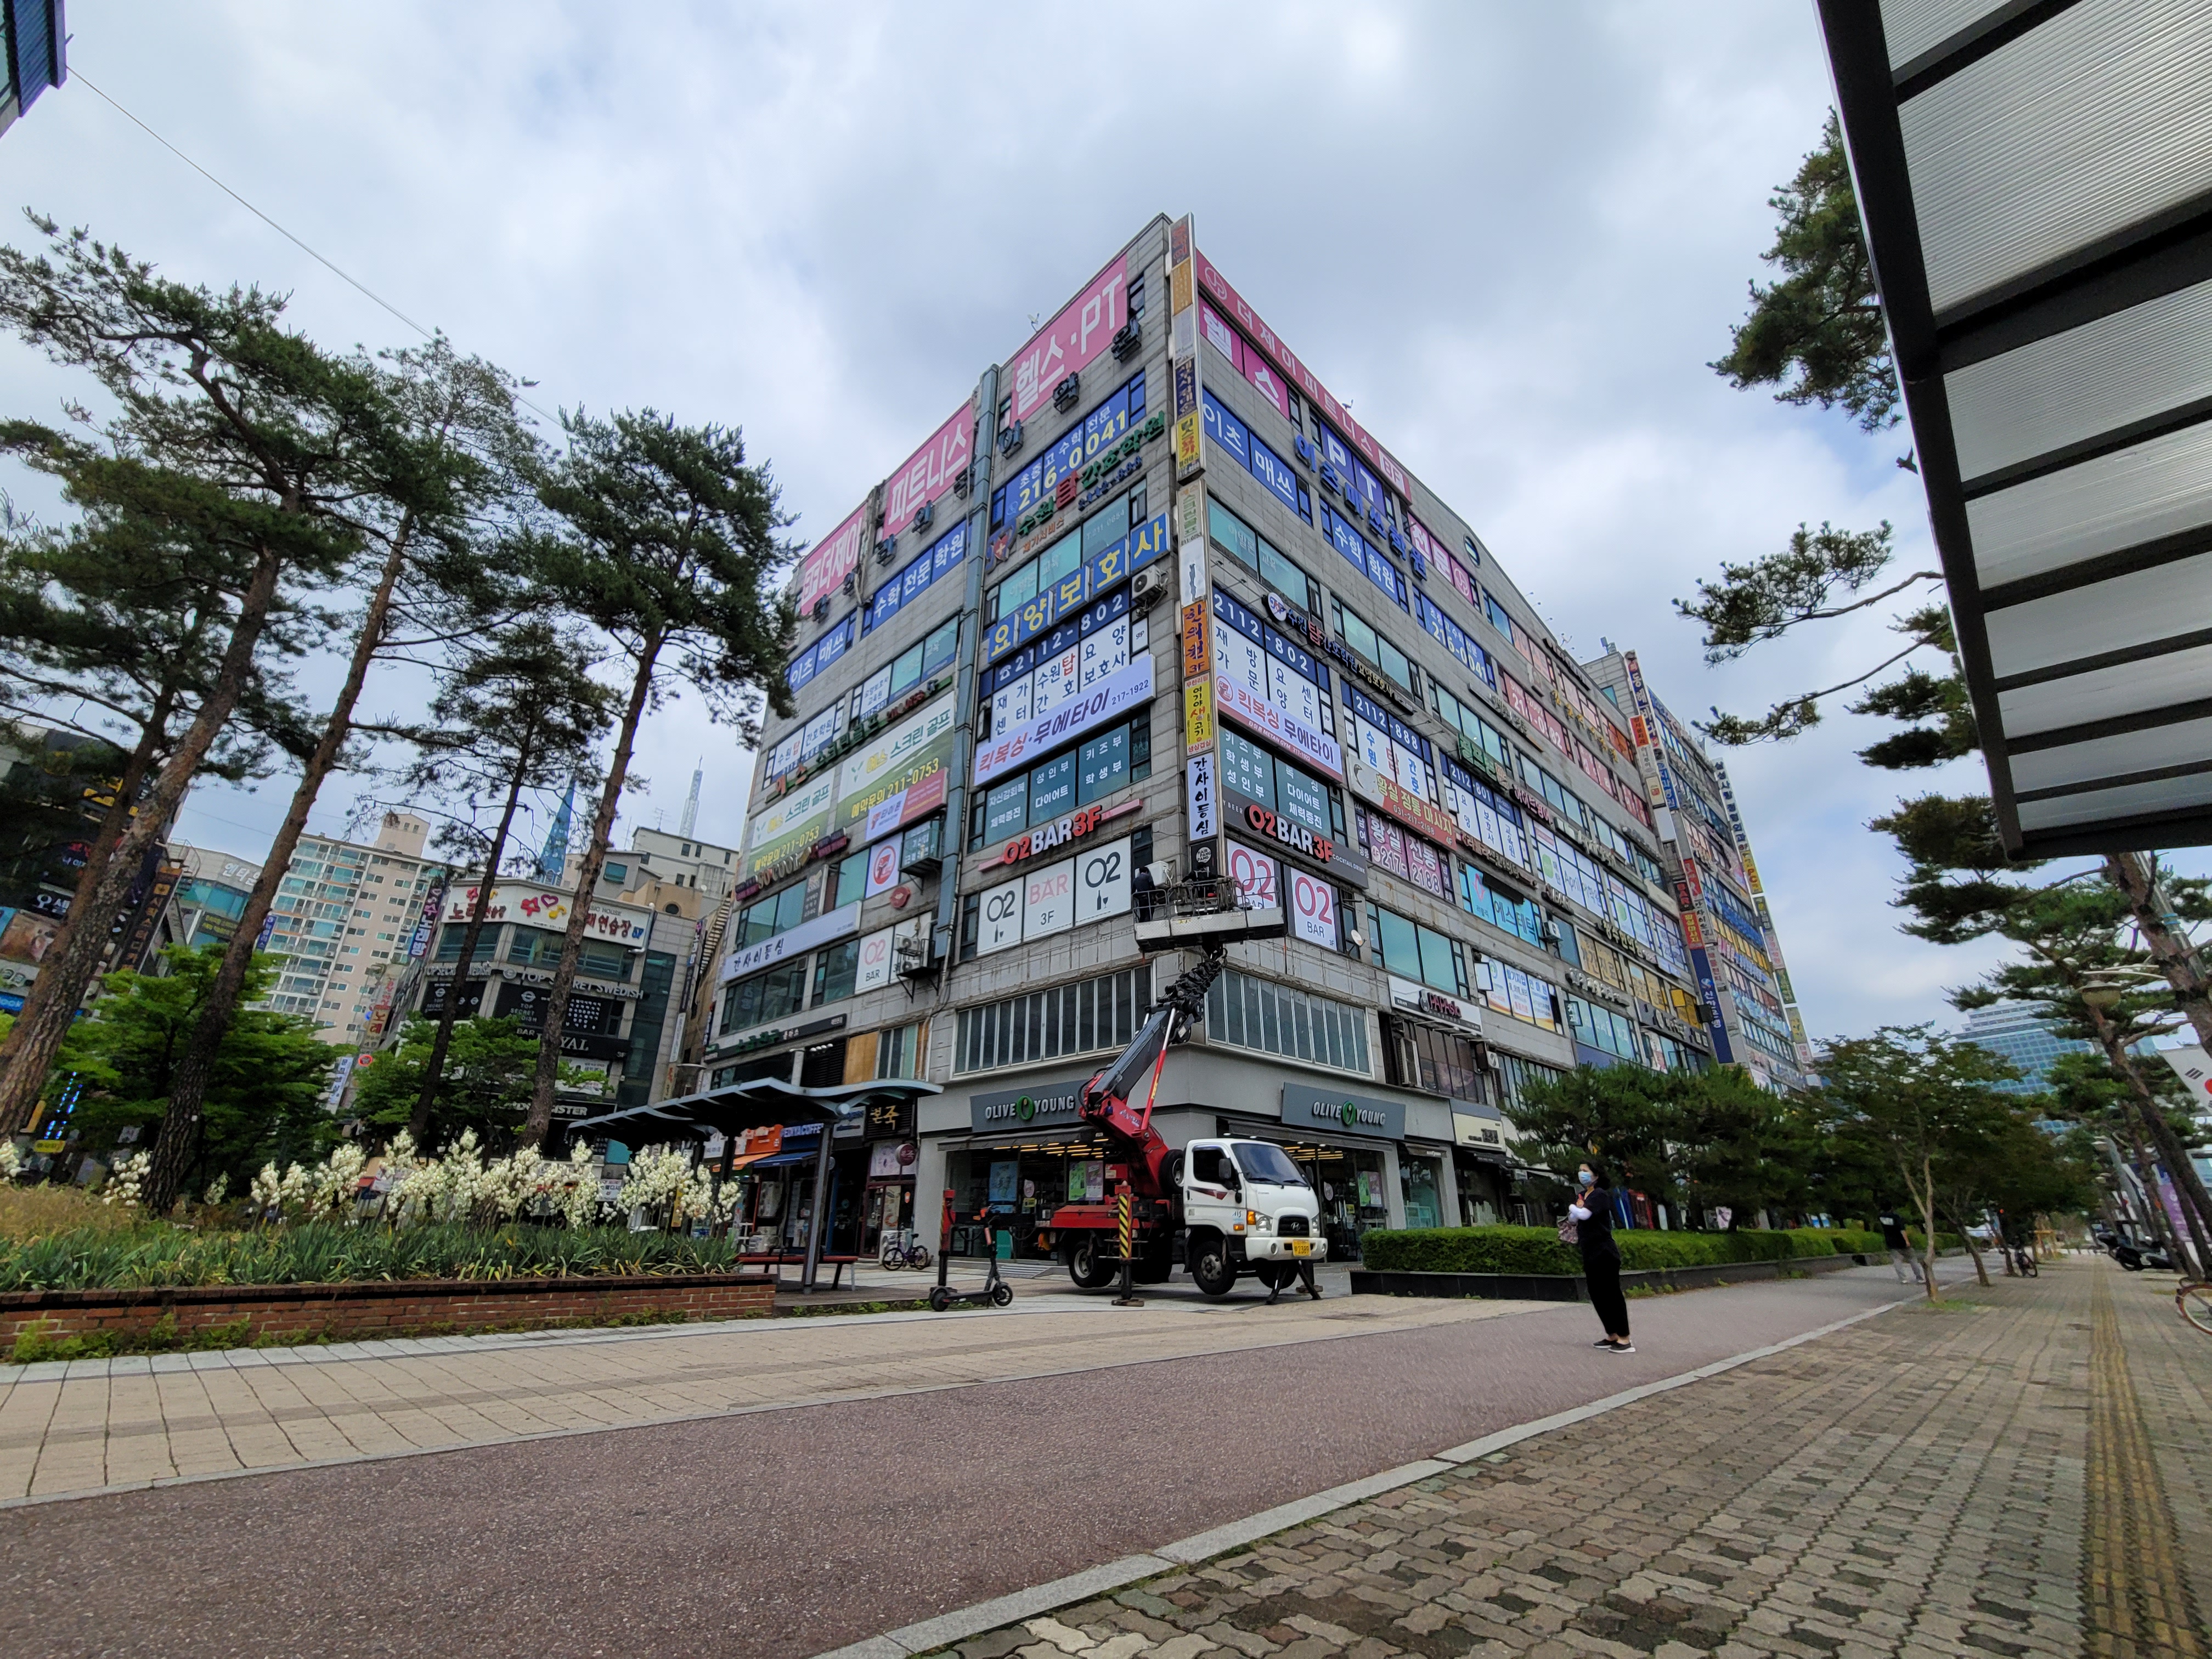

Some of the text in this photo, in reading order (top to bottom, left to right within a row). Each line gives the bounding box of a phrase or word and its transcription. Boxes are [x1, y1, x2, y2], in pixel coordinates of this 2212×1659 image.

[1203, 306, 1281, 410] 헬스
[1328, 434, 1376, 503] PT
[1304, 370, 1374, 458] 피트니스
[1018, 410, 1126, 511] 216-0041
[1019, 407, 1111, 487] 초중고 수학 전문
[888, 423, 967, 526] 피트니스
[1255, 450, 1295, 502] 매쓰
[1335, 524, 1362, 564] 수학
[1369, 553, 1395, 594] 학원
[874, 529, 965, 618] 수학 전문 학원
[991, 521, 1163, 657] 요양보호사
[819, 631, 844, 659] 매쓰
[1015, 594, 1123, 673] 2112-802
[1184, 603, 1206, 659] 한의원
[1214, 594, 1308, 672] 2112-802
[1189, 661, 1205, 674] 3F
[1432, 621, 1487, 682] 216-0041
[1084, 650, 1126, 687] 보호사
[1111, 680, 1149, 706] 217-1922
[806, 716, 833, 747] 간호학원
[890, 725, 924, 758] 스크린
[927, 708, 951, 737] 골프
[1238, 688, 1334, 764] 킥복싱 무에타이
[1356, 696, 1418, 750] 2112-888
[1086, 735, 1122, 761] 키즈부
[1226, 749, 1263, 778] 학생부
[1280, 738, 1291, 749] GYM
[1293, 747, 1312, 761] 217-1922
[888, 757, 939, 798] 211-0753
[1036, 760, 1122, 785] 성인부 학생부
[1227, 769, 1265, 799] 성인부
[785, 798, 809, 822] 스크린
[812, 783, 830, 806] 골프
[1035, 785, 1069, 808] 다이어트
[1194, 758, 1209, 836] 간사이등심
[1287, 783, 1321, 811] 다이어트
[990, 806, 1021, 828] 체력증진
[1289, 802, 1322, 830] 체력증진
[1393, 804, 1435, 836] 031-217-2188
[781, 826, 820, 857] 211-0753
[1370, 815, 1401, 852] 황실
[1029, 873, 1068, 905] BAR
[1040, 910, 1054, 926] 3F
[1307, 921, 1325, 938] BAR
[734, 938, 785, 973] 간사이등심
[521, 973, 545, 983] TOP
[596, 984, 644, 1000] SWEDISH
[865, 969, 881, 982] BAR
[871, 1105, 900, 1130] 본죽
[985, 1096, 1075, 1120] OLIVE YOUNG
[1313, 1101, 1386, 1125] OLIVE YOUNG
